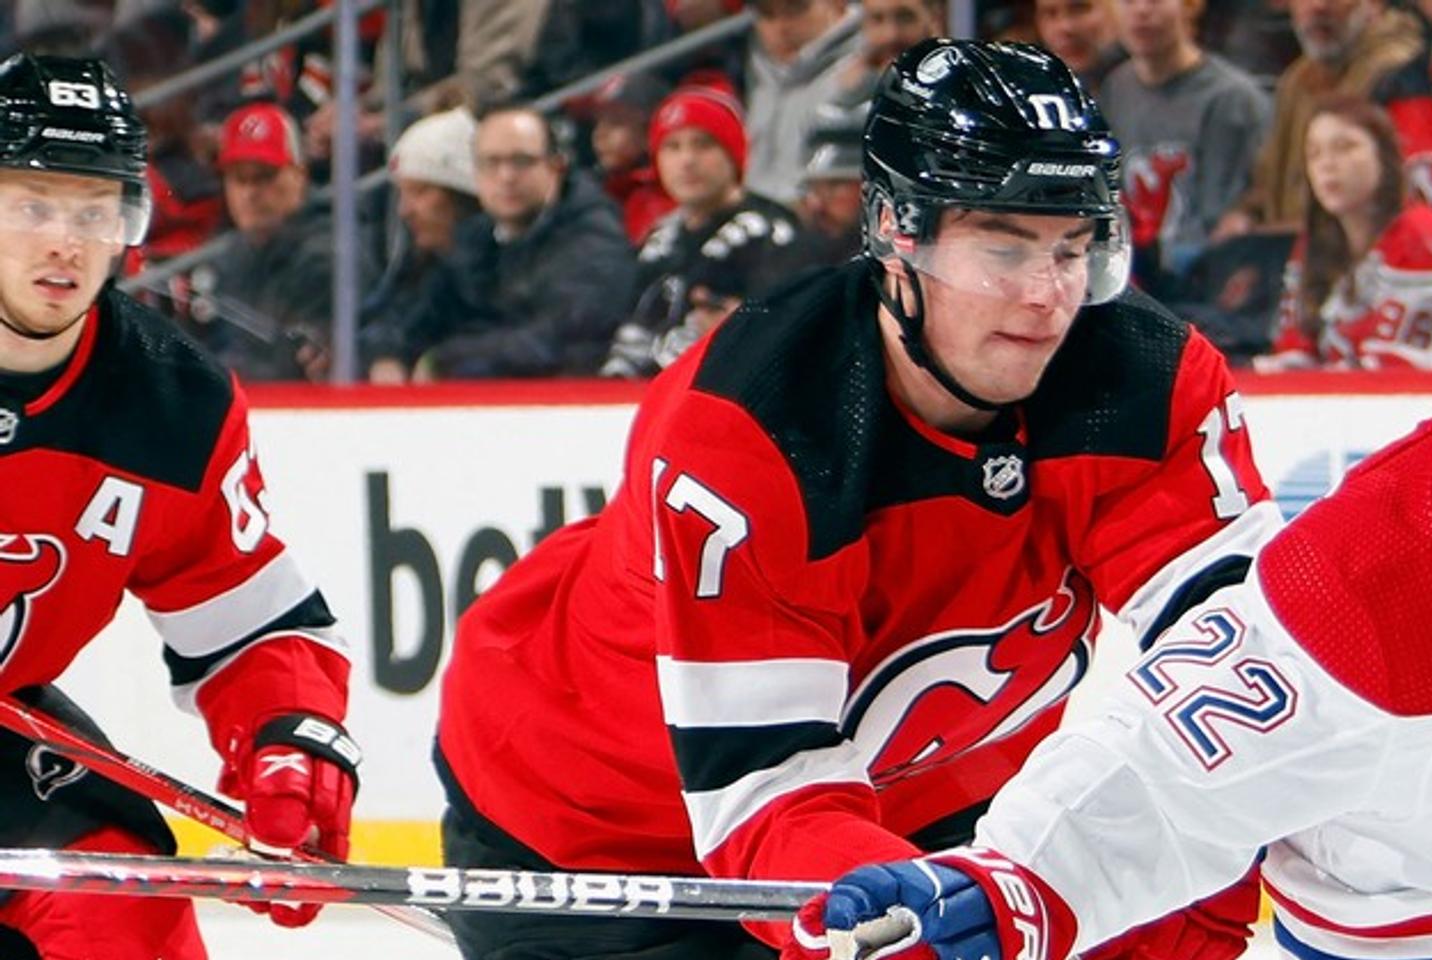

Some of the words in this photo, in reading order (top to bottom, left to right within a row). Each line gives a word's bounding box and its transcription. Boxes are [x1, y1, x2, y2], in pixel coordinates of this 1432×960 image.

[48, 80, 100, 109] 63
[74, 475, 145, 556] A
[1126, 607, 1298, 773] 22
